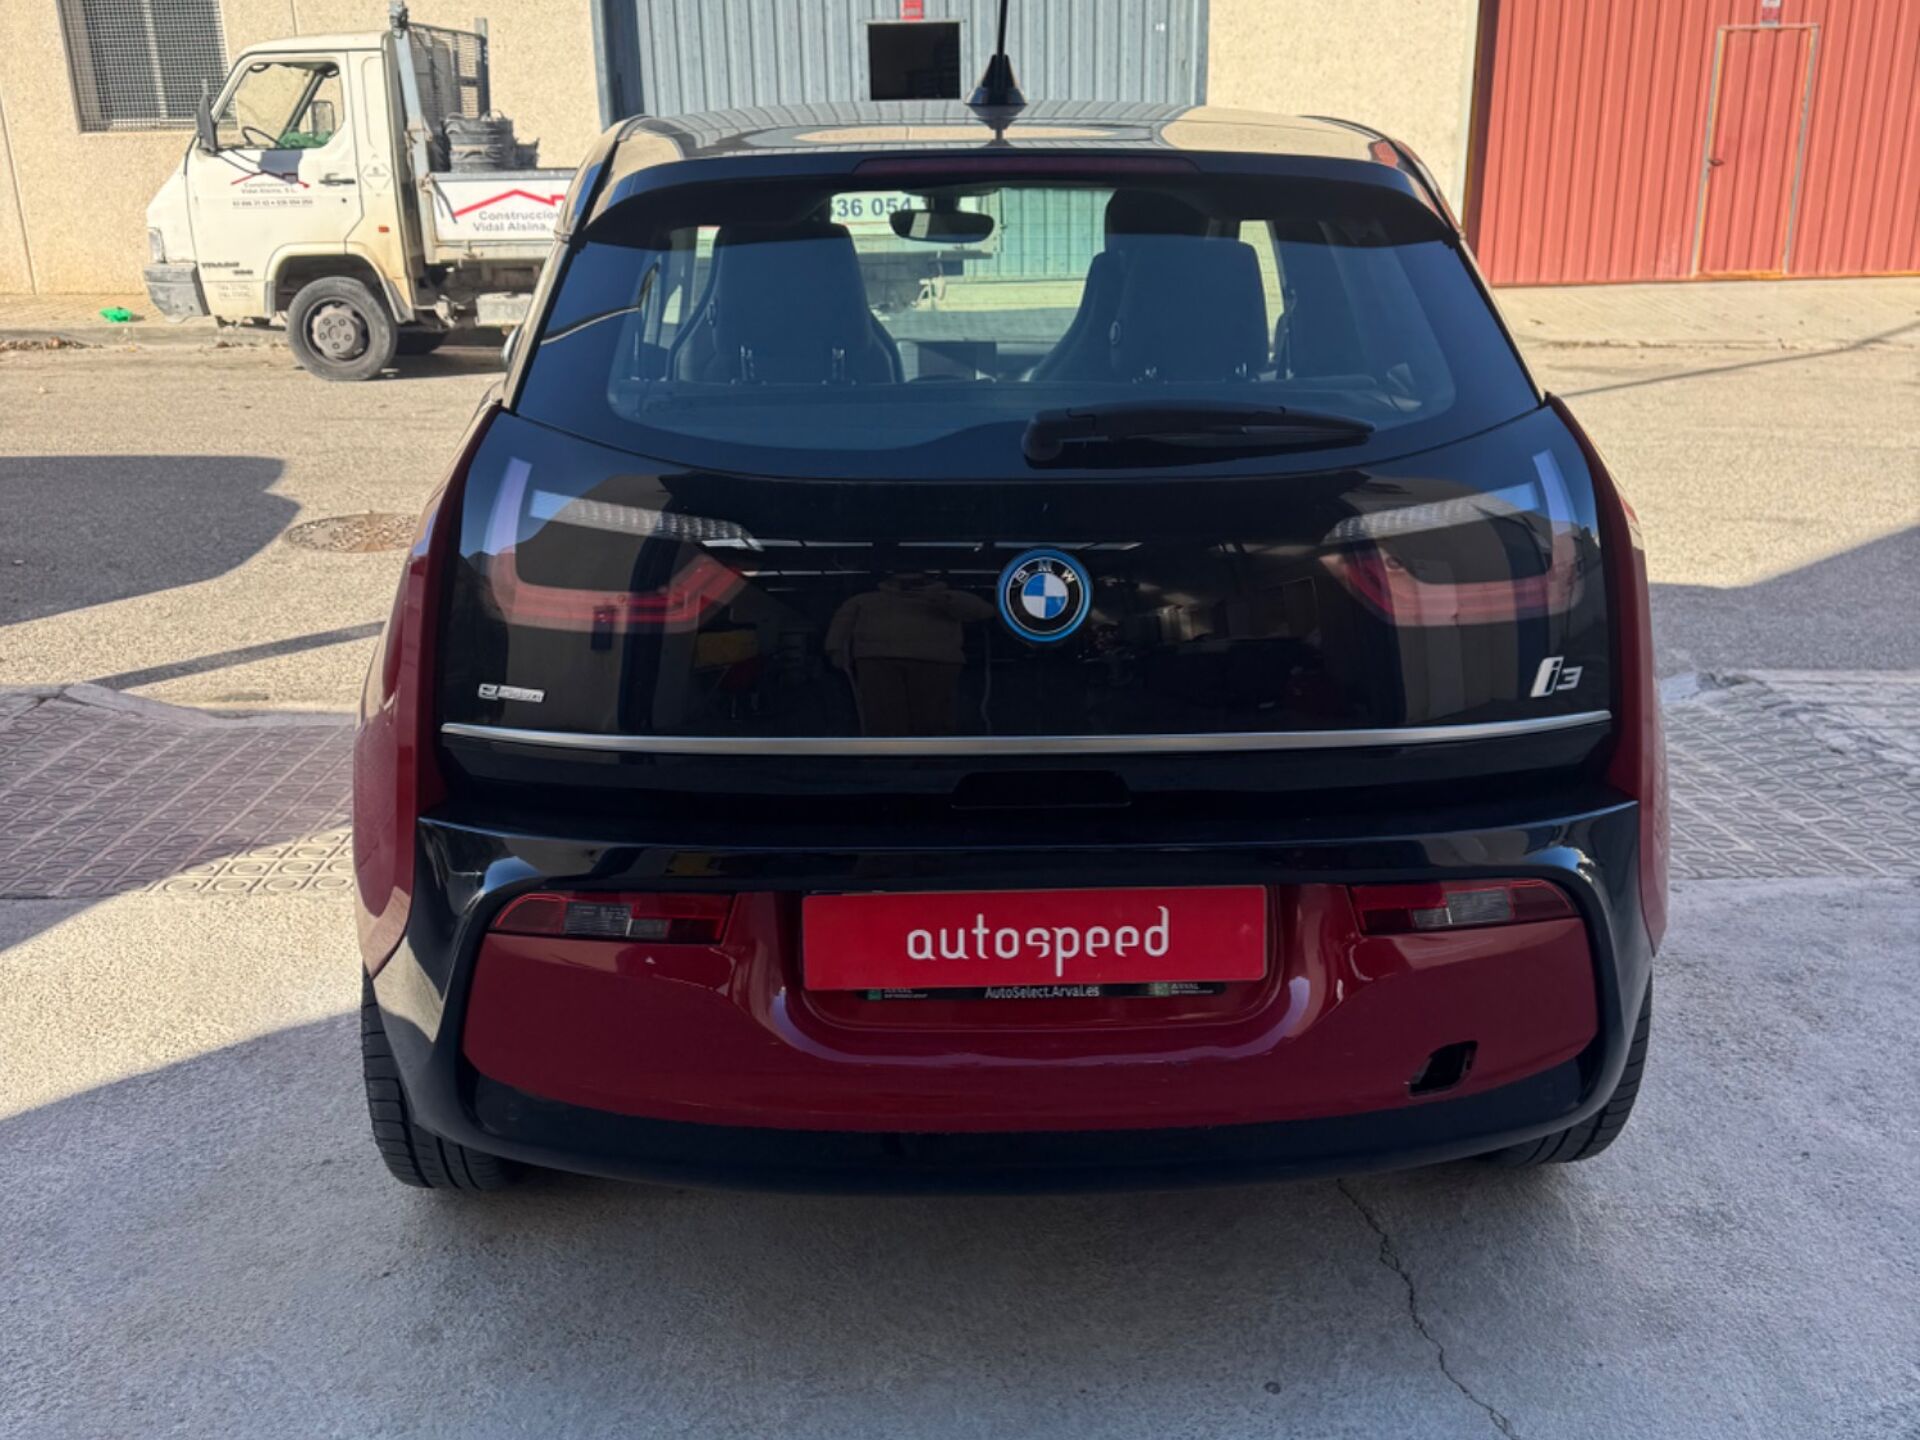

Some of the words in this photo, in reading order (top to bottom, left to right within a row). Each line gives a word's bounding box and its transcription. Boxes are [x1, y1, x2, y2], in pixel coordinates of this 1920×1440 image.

[831, 197, 863, 217] 36
[473, 222, 504, 232] Vidal
[507, 222, 551, 232] Alsina,
[1014, 559, 1076, 584] BMW
[1530, 656, 1583, 697] i3
[907, 905, 1169, 977] autospeed
